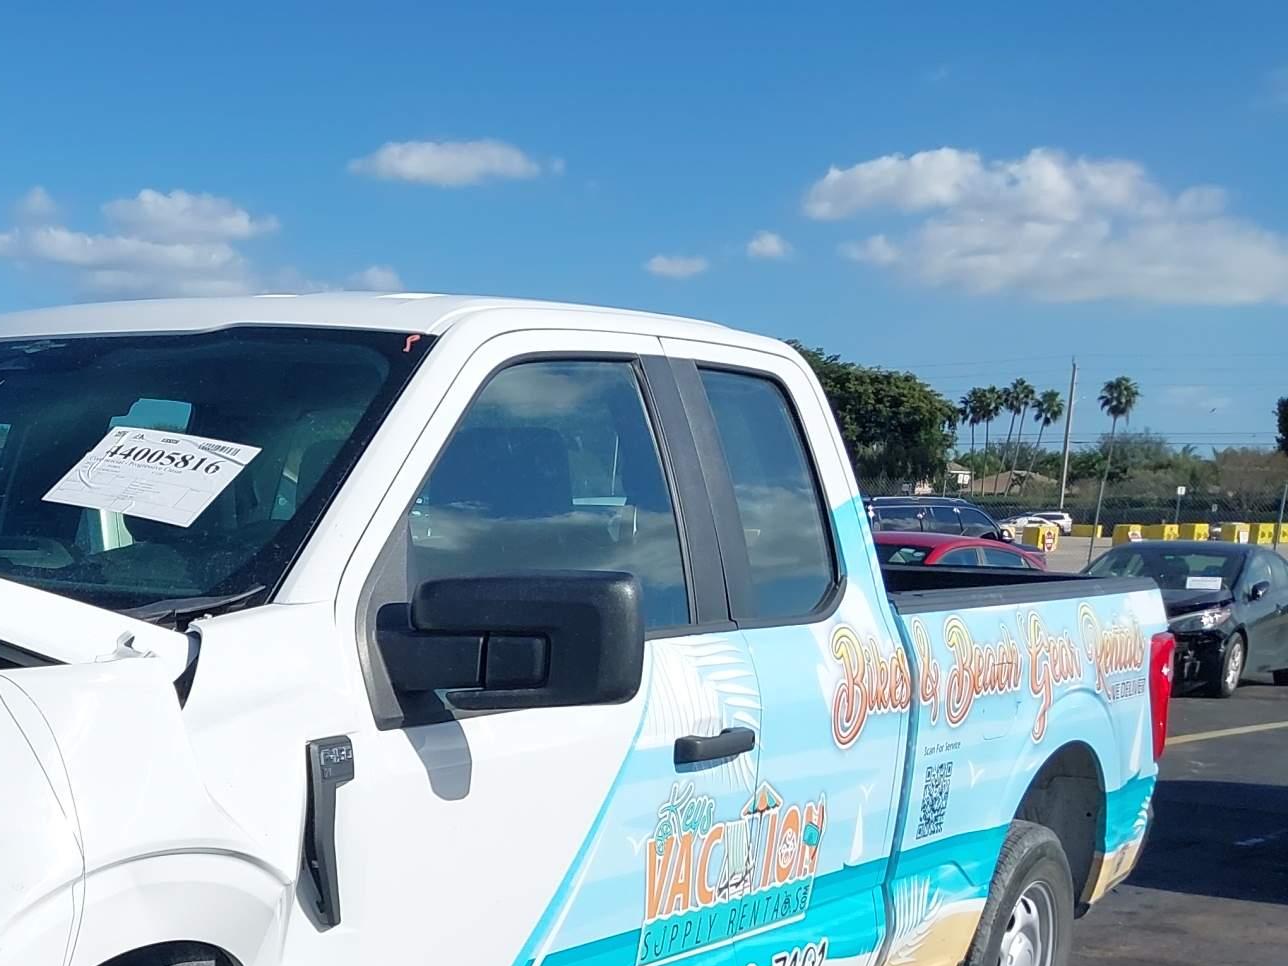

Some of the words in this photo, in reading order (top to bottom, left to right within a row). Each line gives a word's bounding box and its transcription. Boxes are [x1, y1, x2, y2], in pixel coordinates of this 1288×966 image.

[105, 444, 226, 475] 44005816
[832, 624, 912, 748] Bikes
[944, 615, 1022, 728] Beach
[1016, 610, 1082, 743] Gear
[1078, 602, 1143, 703] Rentals
[658, 784, 714, 837] Keys
[640, 911, 718, 961] SUPPLY
[726, 884, 804, 937] RENTAS
